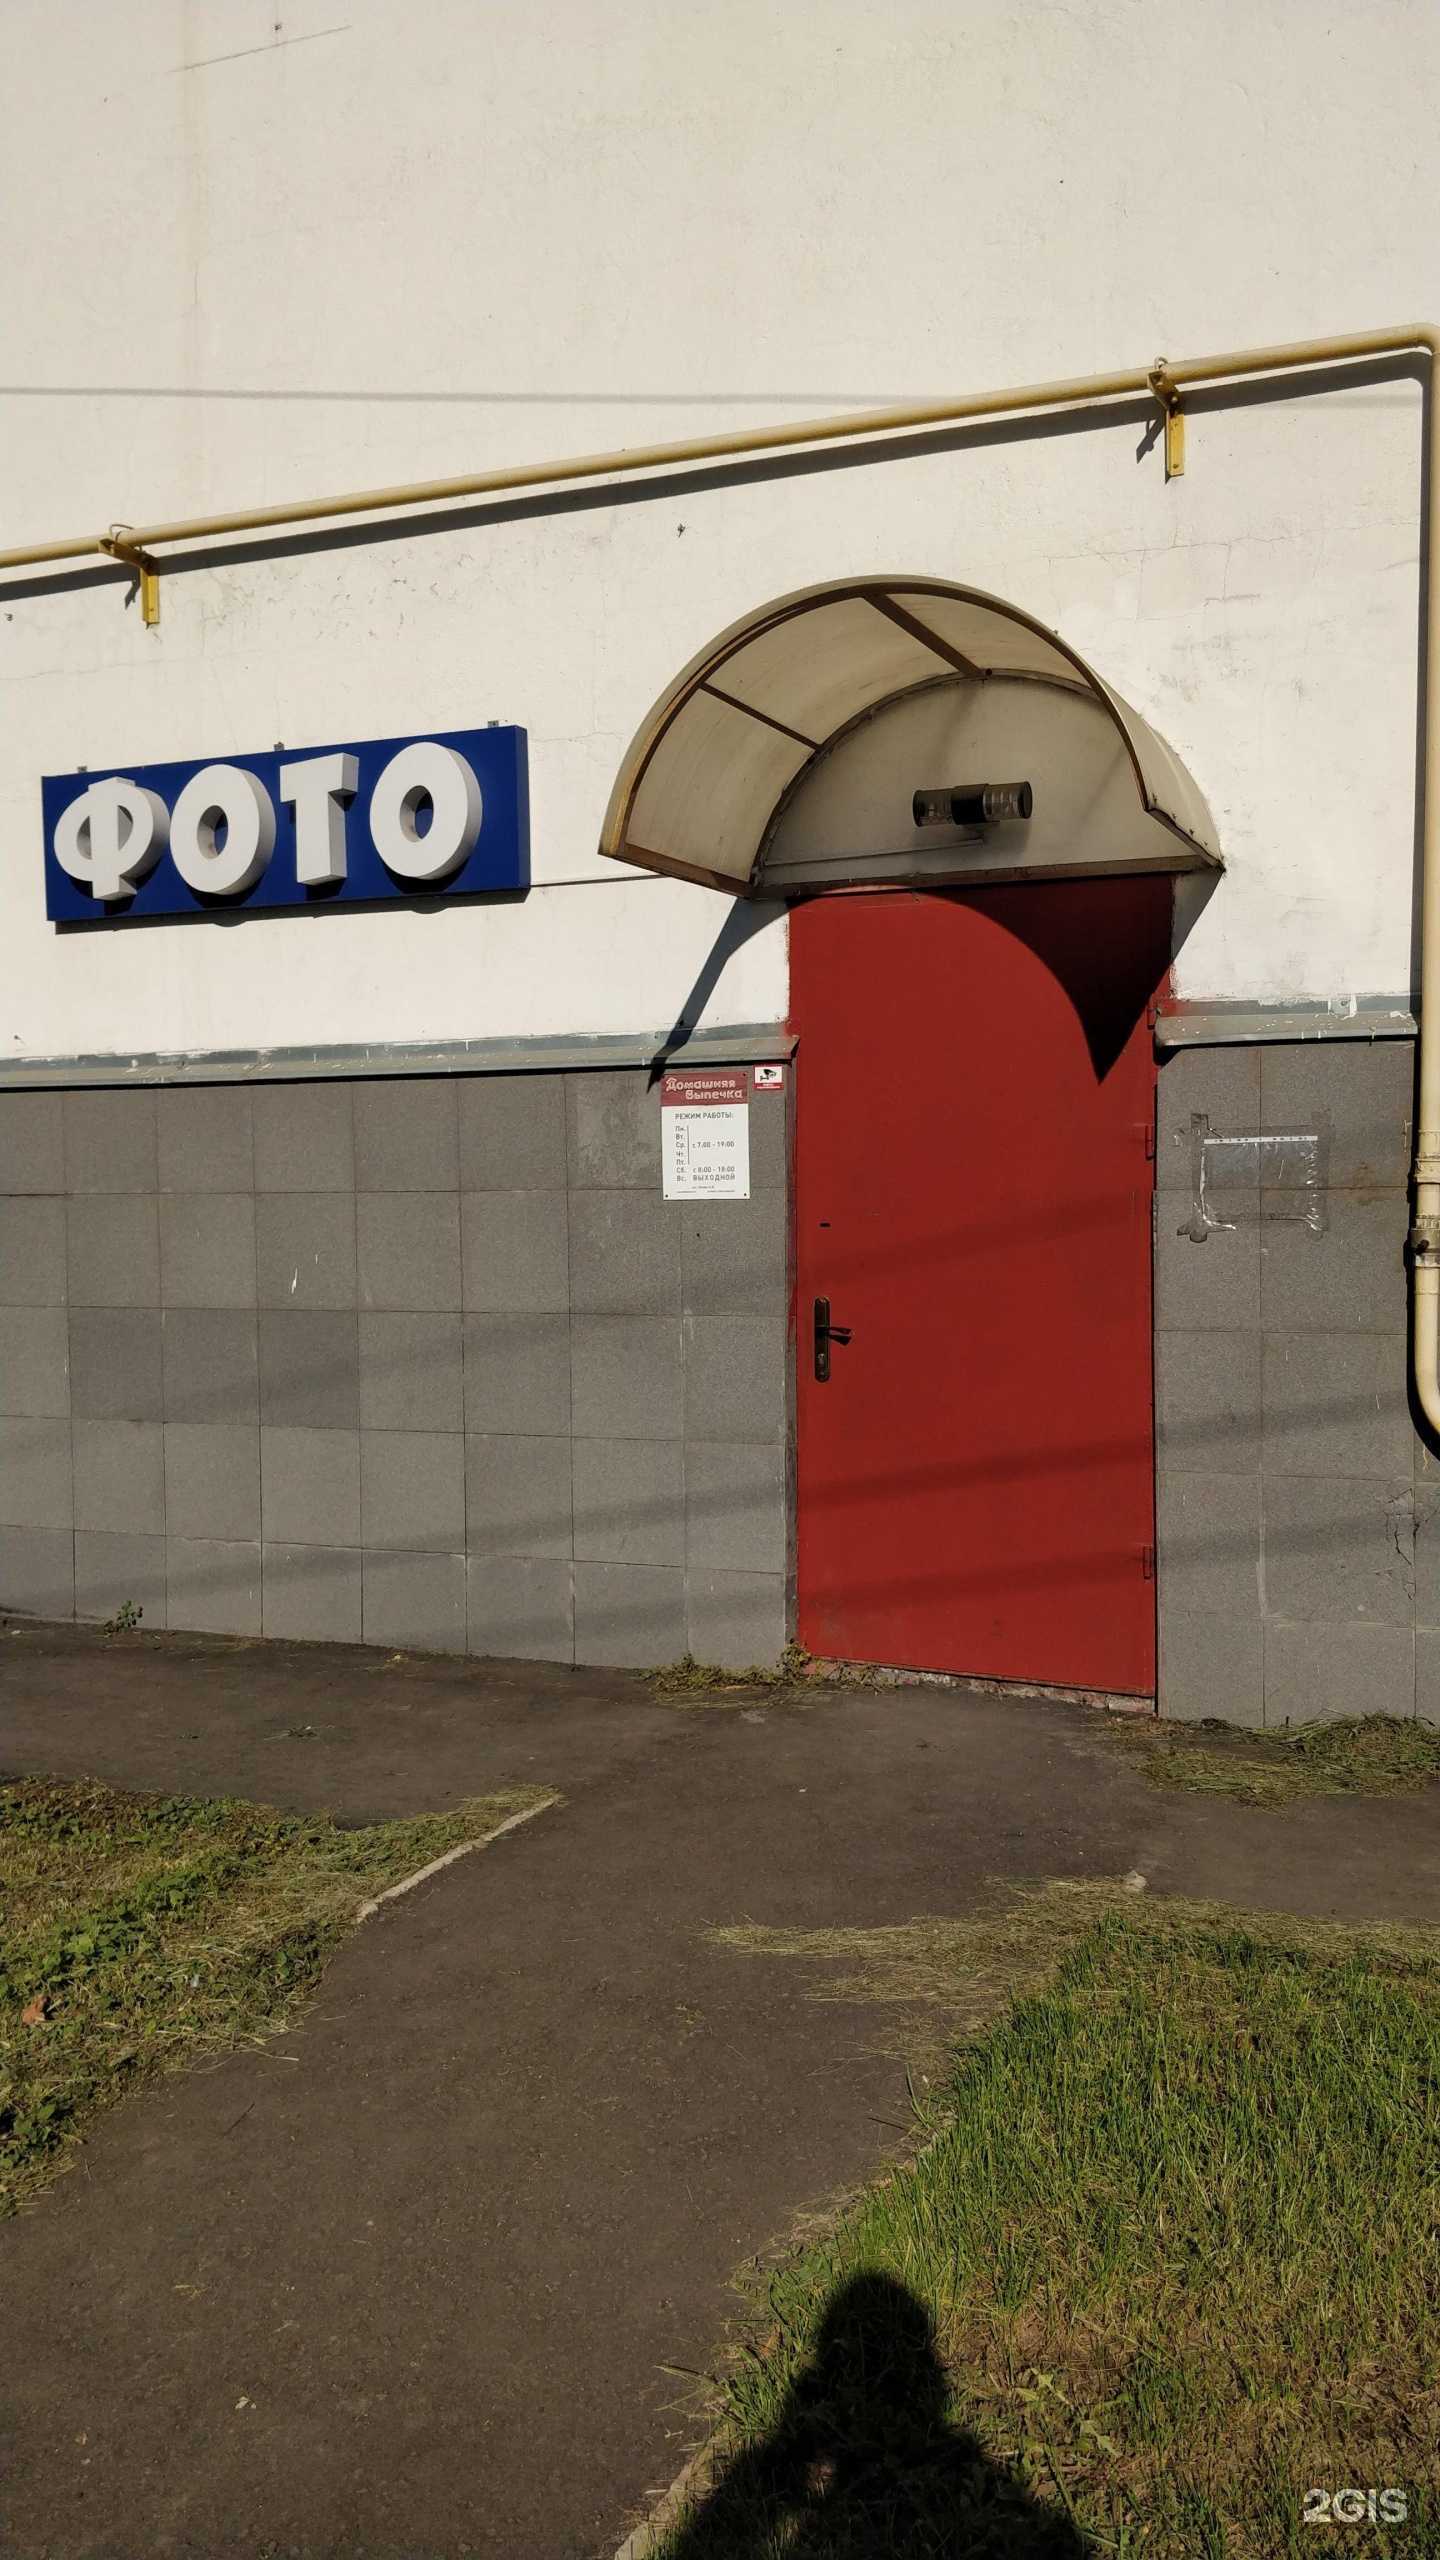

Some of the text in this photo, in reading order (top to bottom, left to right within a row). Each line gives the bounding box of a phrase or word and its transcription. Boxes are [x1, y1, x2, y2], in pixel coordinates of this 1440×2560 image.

[54, 742, 482, 900] ФОТО
[666, 1077, 736, 1091] Домашняя
[692, 1173, 736, 1182] ВЫХОДНОЙ
